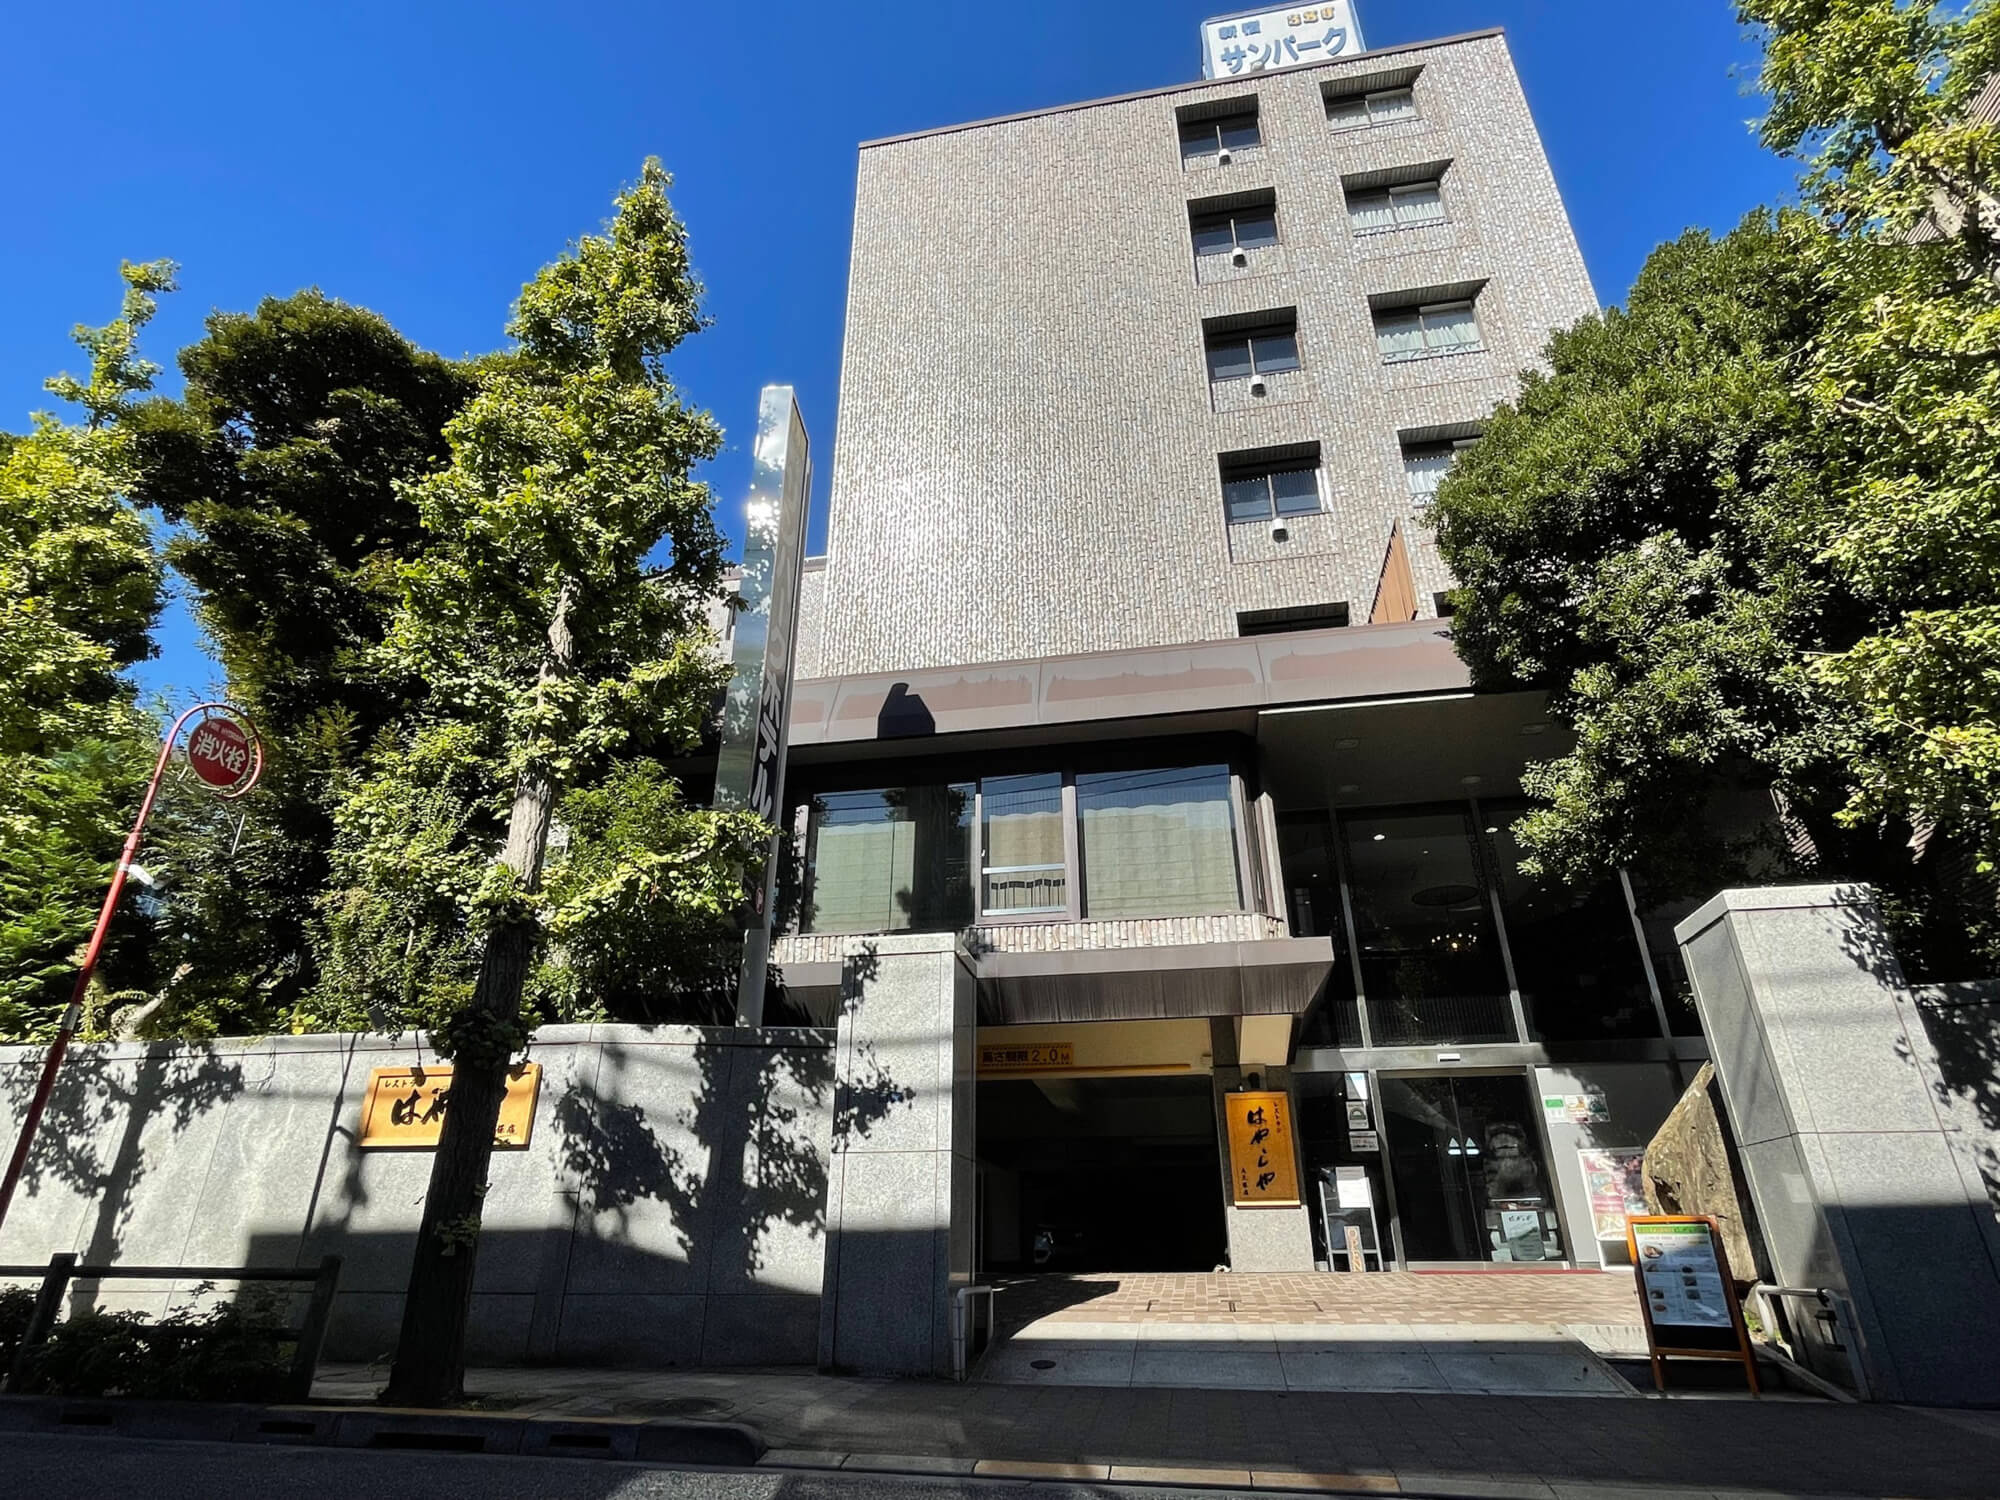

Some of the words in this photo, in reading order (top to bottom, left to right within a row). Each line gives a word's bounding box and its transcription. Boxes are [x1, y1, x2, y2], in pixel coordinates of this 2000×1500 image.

[1221, 27, 1347, 74] サンパーク
[193, 729, 247, 775] 消火栓
[1347, 1228, 1363, 1273] OPEN
